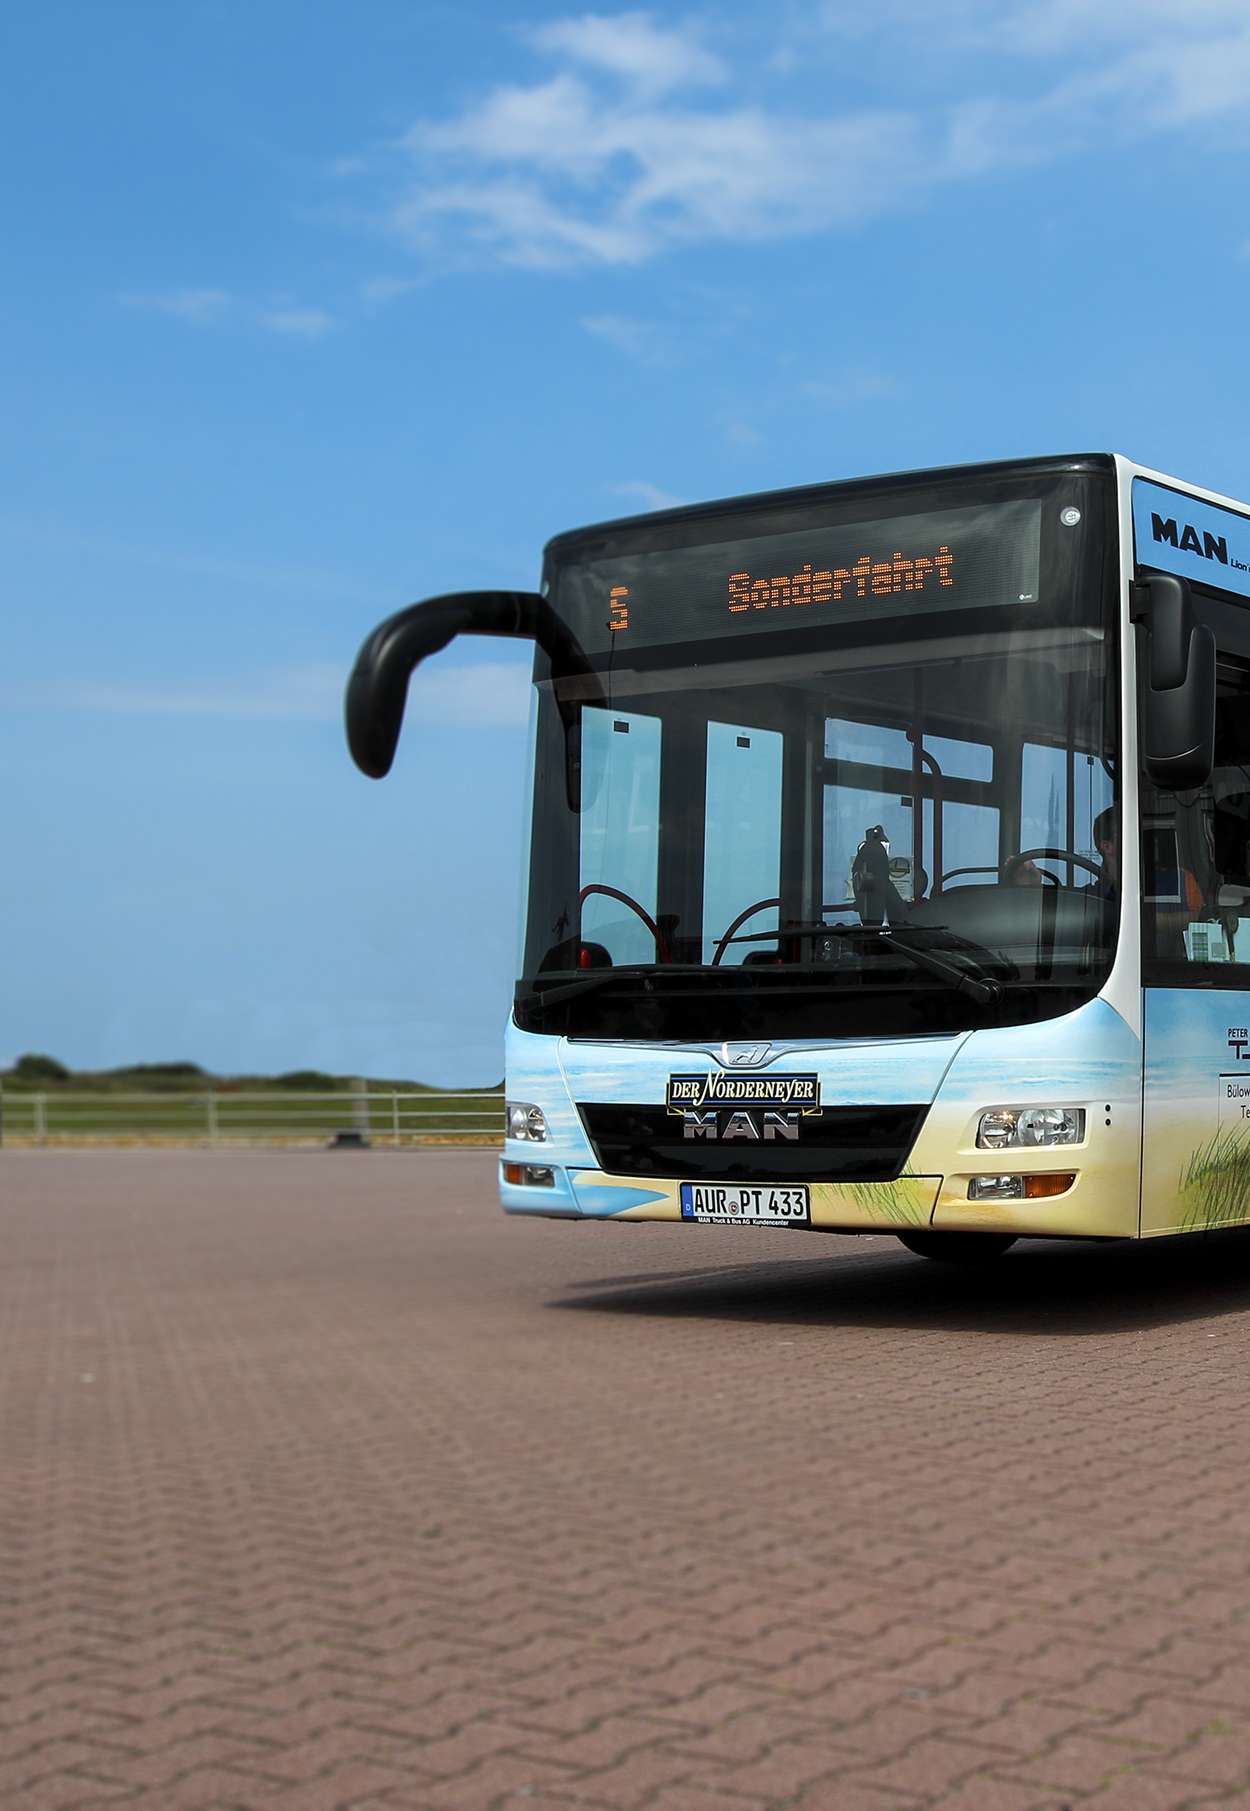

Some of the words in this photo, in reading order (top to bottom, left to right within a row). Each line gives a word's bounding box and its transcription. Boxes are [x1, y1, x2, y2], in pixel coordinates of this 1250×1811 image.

[1151, 512, 1228, 565] MAN
[728, 545, 953, 613] Sonderfahrt
[1228, 1028, 1248, 1038] PETER
[672, 1081, 700, 1098] DER
[683, 1111, 800, 1140] MAN
[695, 1188, 728, 1214] AUR
[739, 1190, 762, 1215] PT
[768, 1190, 804, 1216] 433
